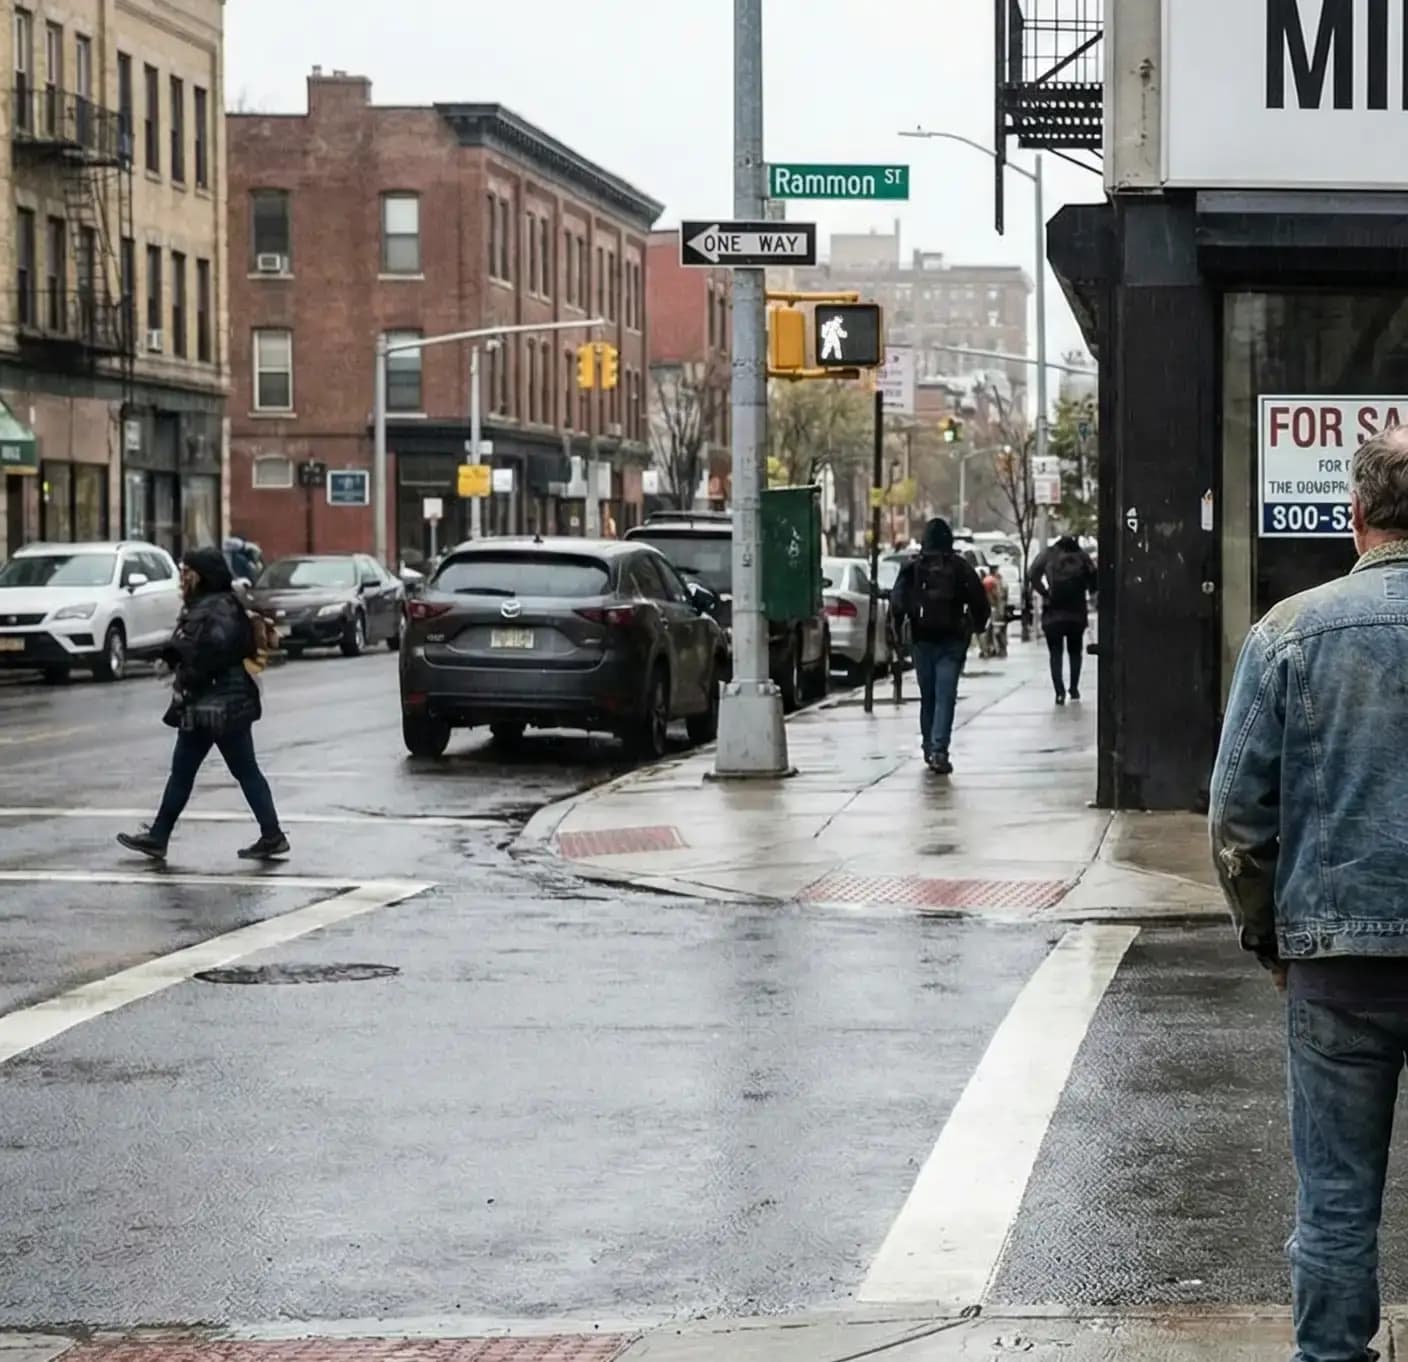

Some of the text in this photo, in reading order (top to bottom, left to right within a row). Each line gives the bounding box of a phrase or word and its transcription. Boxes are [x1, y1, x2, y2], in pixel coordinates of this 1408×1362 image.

[774, 167, 902, 195] Rammon ST
[703, 234, 799, 252] ONE WAY
[1269, 406, 1344, 448] FOR
[1318, 459, 1342, 473] FOR
